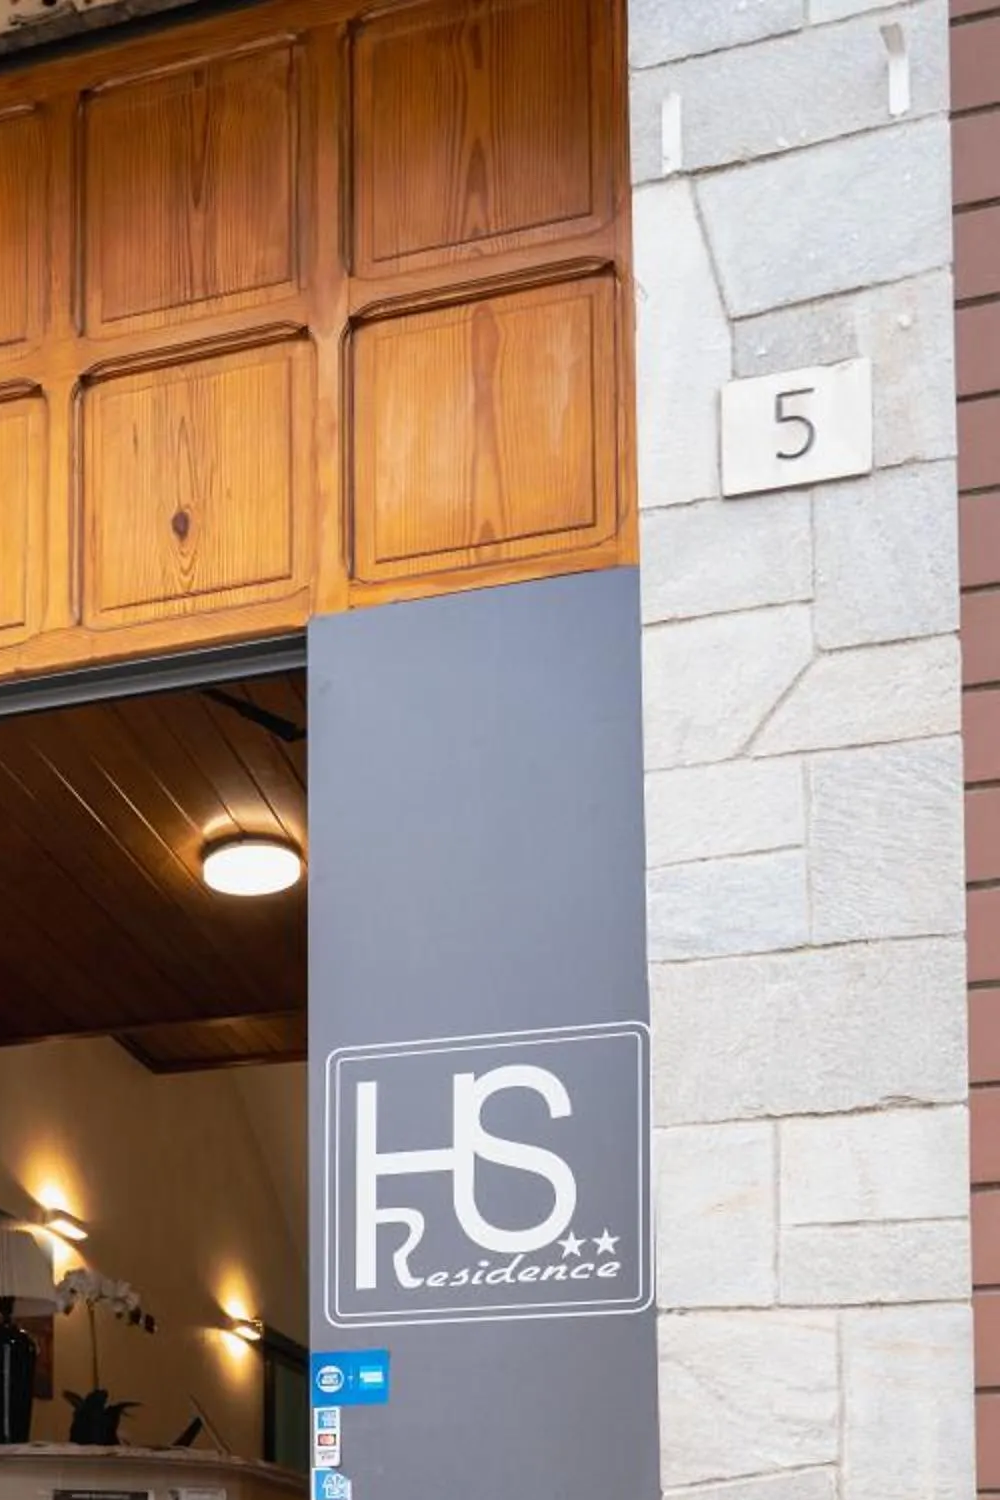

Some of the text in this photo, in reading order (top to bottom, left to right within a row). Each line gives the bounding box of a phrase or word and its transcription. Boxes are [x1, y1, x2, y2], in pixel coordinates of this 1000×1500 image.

[775, 387, 815, 460] 5
[356, 1064, 577, 1260] HS
[356, 1207, 622, 1290] Residence
